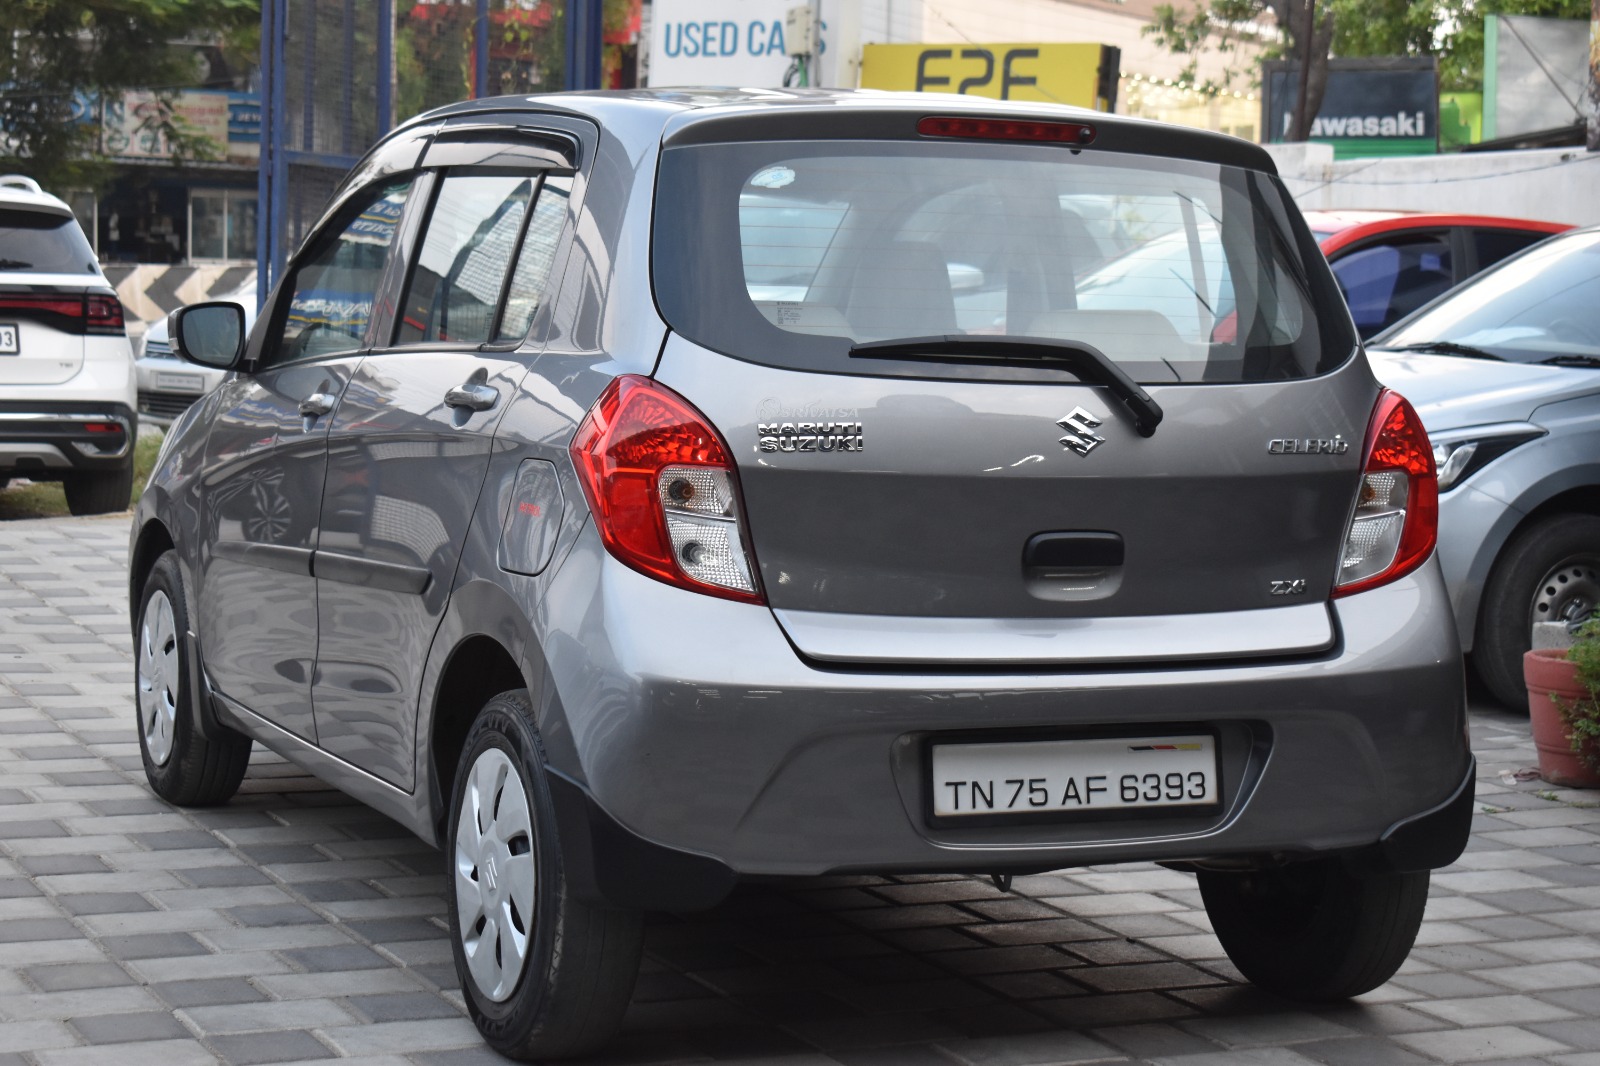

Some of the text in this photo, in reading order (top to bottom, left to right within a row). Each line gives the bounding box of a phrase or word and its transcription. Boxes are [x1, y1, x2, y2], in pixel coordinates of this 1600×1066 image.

[665, 20, 828, 58] USED CAS
[757, 421, 863, 435] MARUTI
[759, 435, 864, 453] SUZUKI
[944, 771, 1206, 811] TN 75 AF 6393
